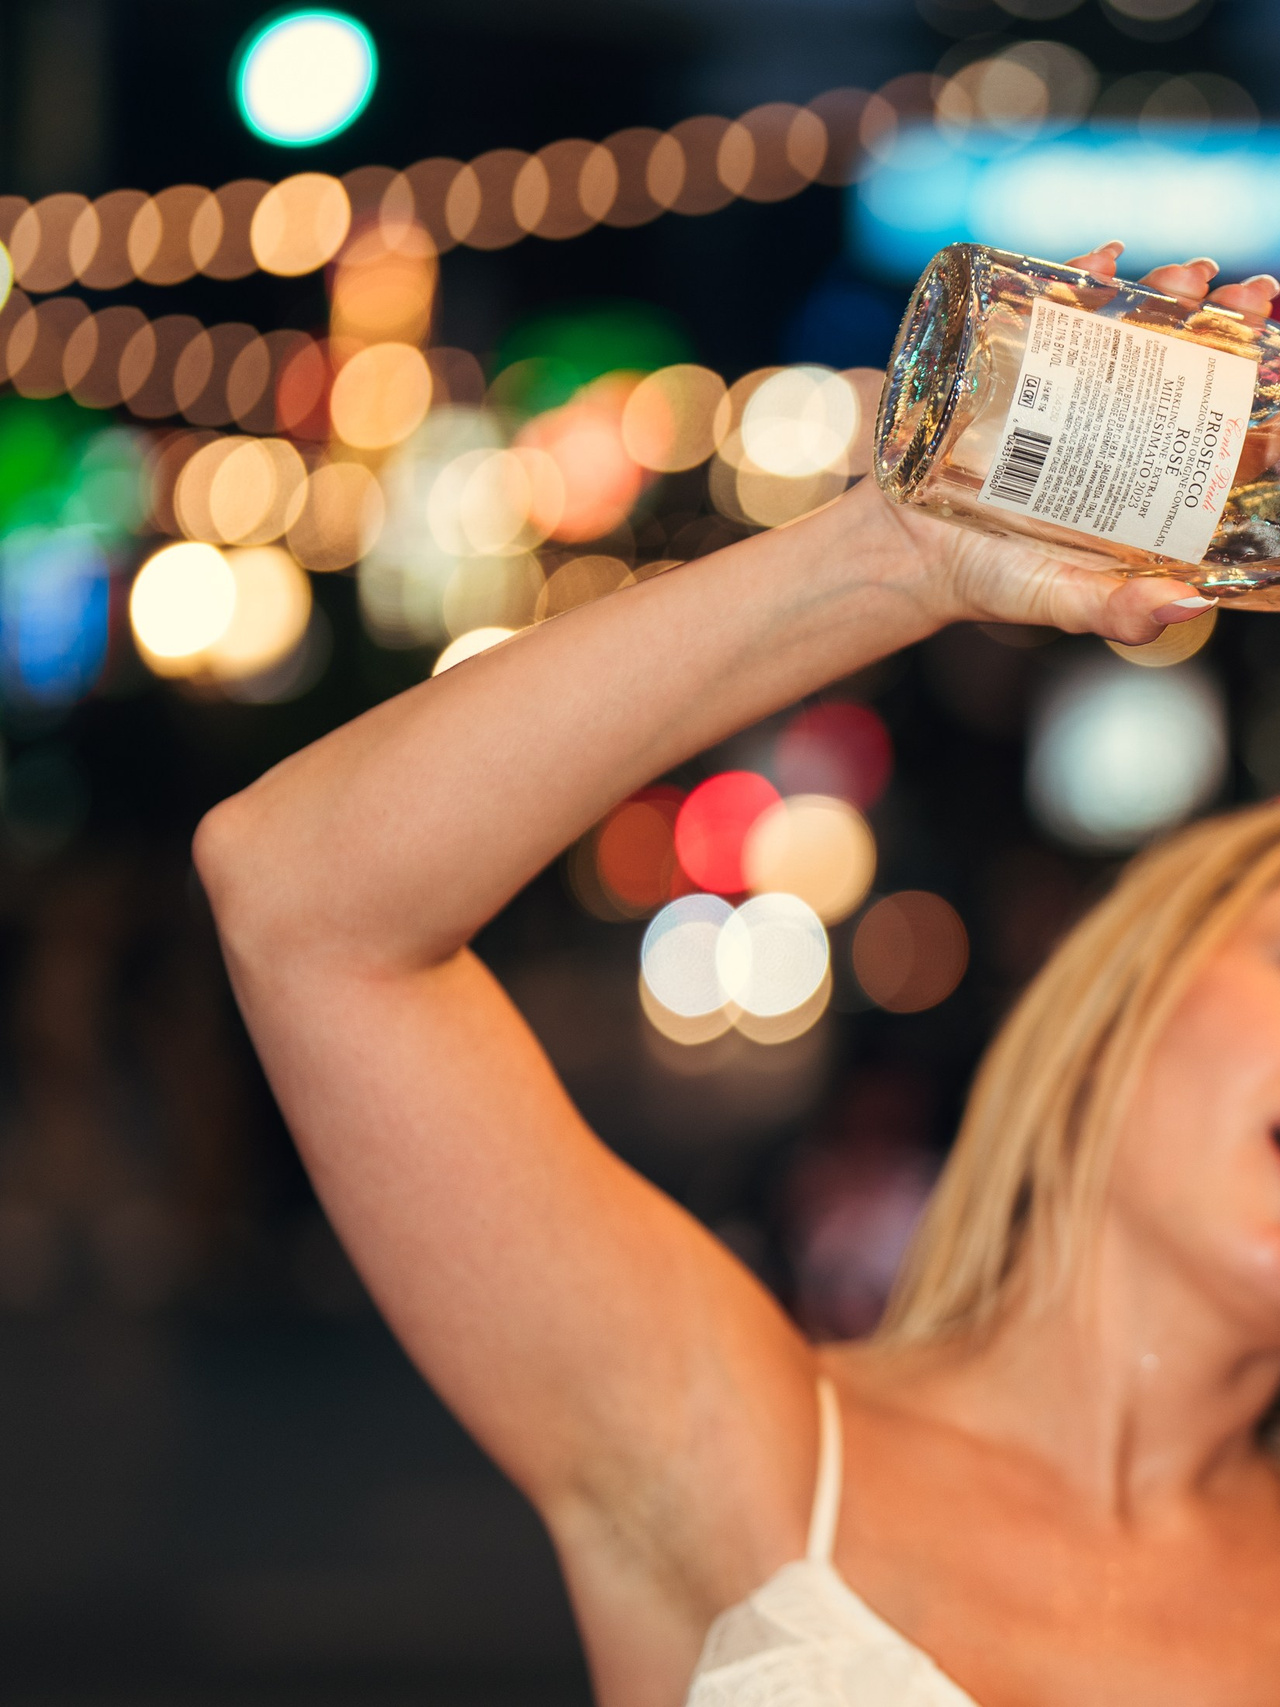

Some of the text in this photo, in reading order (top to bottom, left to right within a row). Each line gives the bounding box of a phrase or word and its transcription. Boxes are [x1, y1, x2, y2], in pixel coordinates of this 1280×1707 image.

[1031, 306, 1046, 354] CONTAINS SULFITES
[1041, 309, 1056, 352] PRODUCT OF ITALY
[1055, 327, 1067, 342] 11%
[1057, 312, 1069, 328] ALC.
[1066, 347, 1079, 368] 750ml
[1121, 333, 1134, 363] IMPORTED
[1128, 345, 1142, 378] PRODUCED
[1021, 378, 1038, 405] CA CRV
[1115, 374, 1127, 397] PLUME
[1125, 378, 1135, 393] AND
[1117, 393, 1132, 423] BOTTLED
[1167, 375, 1186, 429] SPARKLING
[1000, 434, 1016, 462] 04331
[1127, 379, 1174, 509] MILLESIMATO 2023
[1158, 431, 1173, 460] WINE
[1165, 427, 1192, 478] ROSÉ
[1191, 436, 1200, 447] DI
[1094, 460, 1104, 470] CA
[1178, 448, 1197, 489] ORIGINE
[1183, 410, 1224, 509] PROSECCO
[1201, 415, 1246, 516] Conte Priuli
[989, 464, 1005, 490] 00860
[1092, 463, 1112, 500] SALGAREDA
[1145, 466, 1163, 499] EXTRA
[1084, 501, 1098, 519] ITALIA
[1137, 500, 1151, 519] DRY
[1154, 489, 1184, 549] CONTROLLATA
